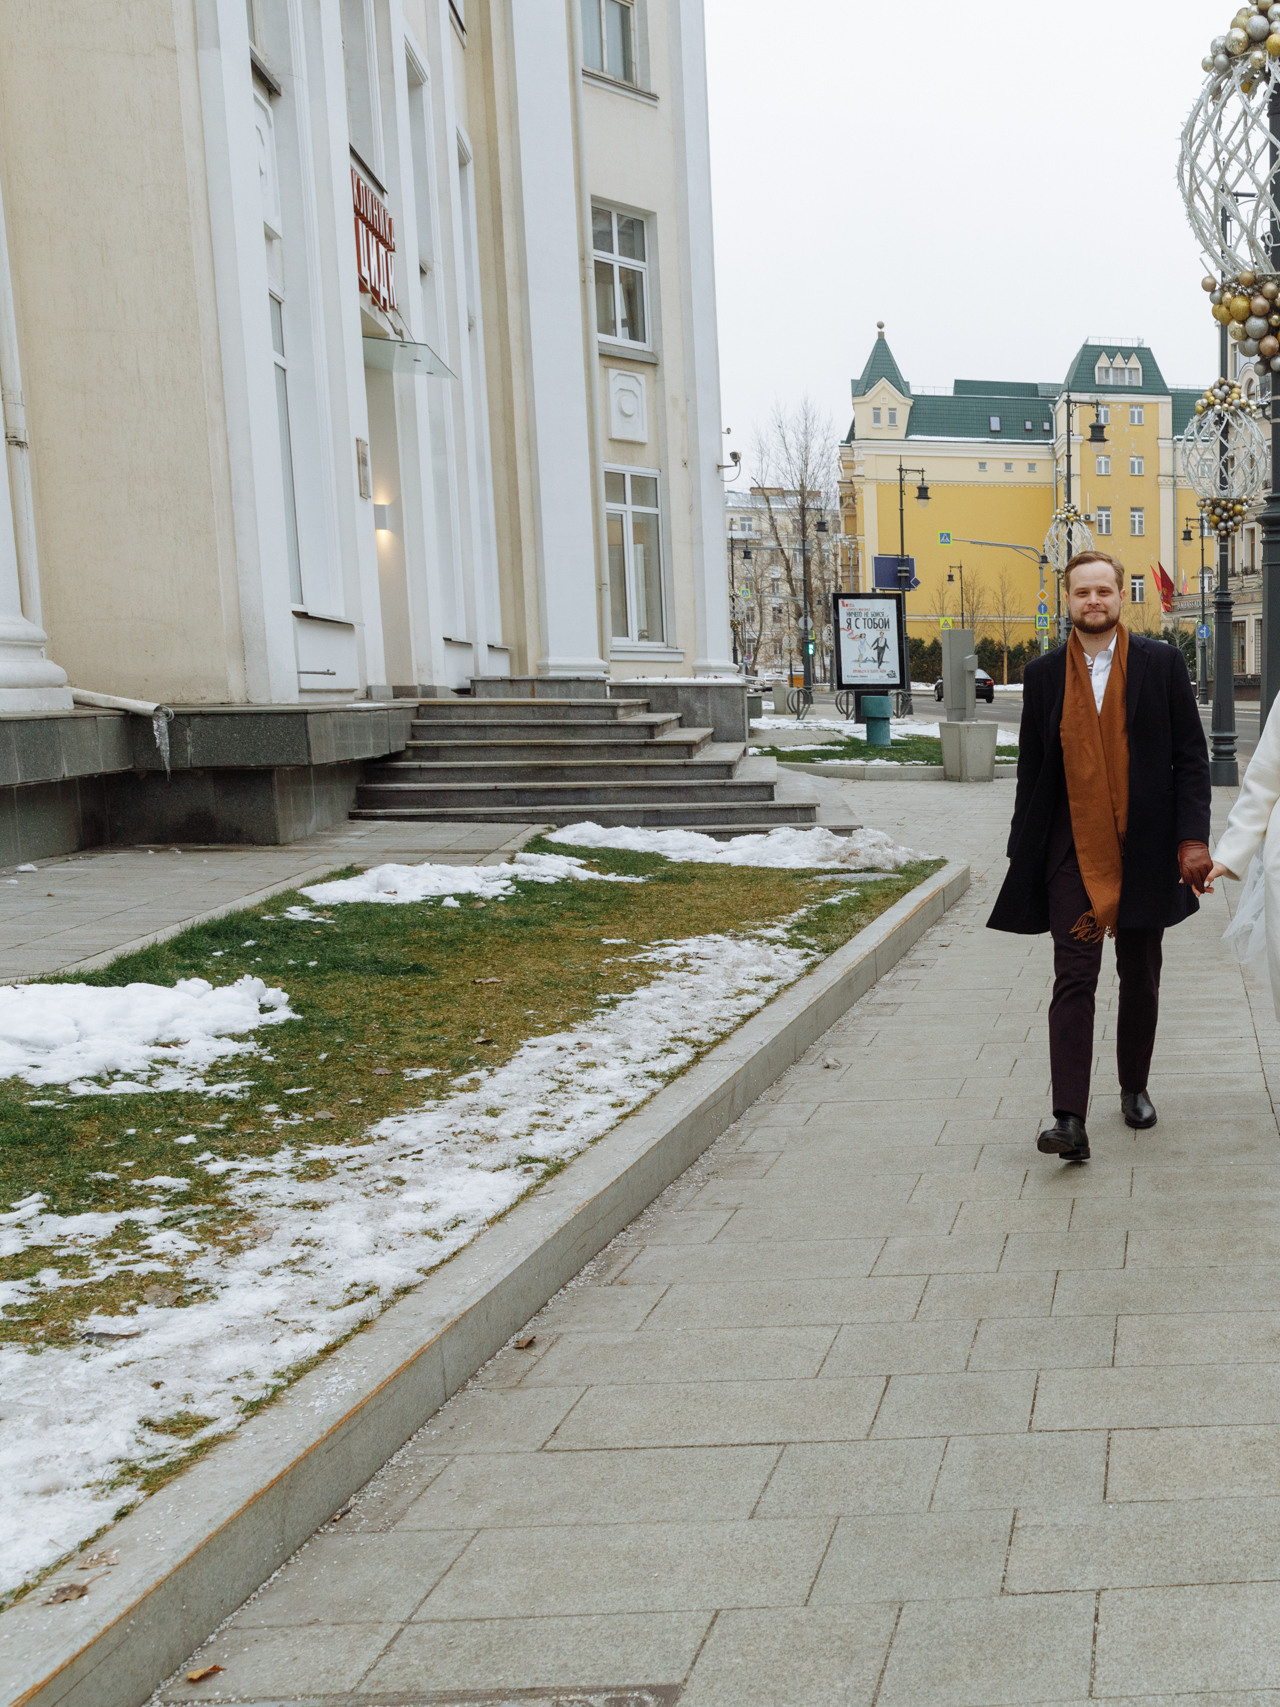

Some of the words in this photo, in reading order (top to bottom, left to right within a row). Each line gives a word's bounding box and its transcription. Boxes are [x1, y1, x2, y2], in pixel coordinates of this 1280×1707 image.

[351, 168, 395, 252] КЛИНИКА
[355, 217, 398, 312] ЦИДК
[846, 618, 852, 629] Я
[855, 618, 861, 630] С
[862, 616, 890, 630] ТОБОЙ
